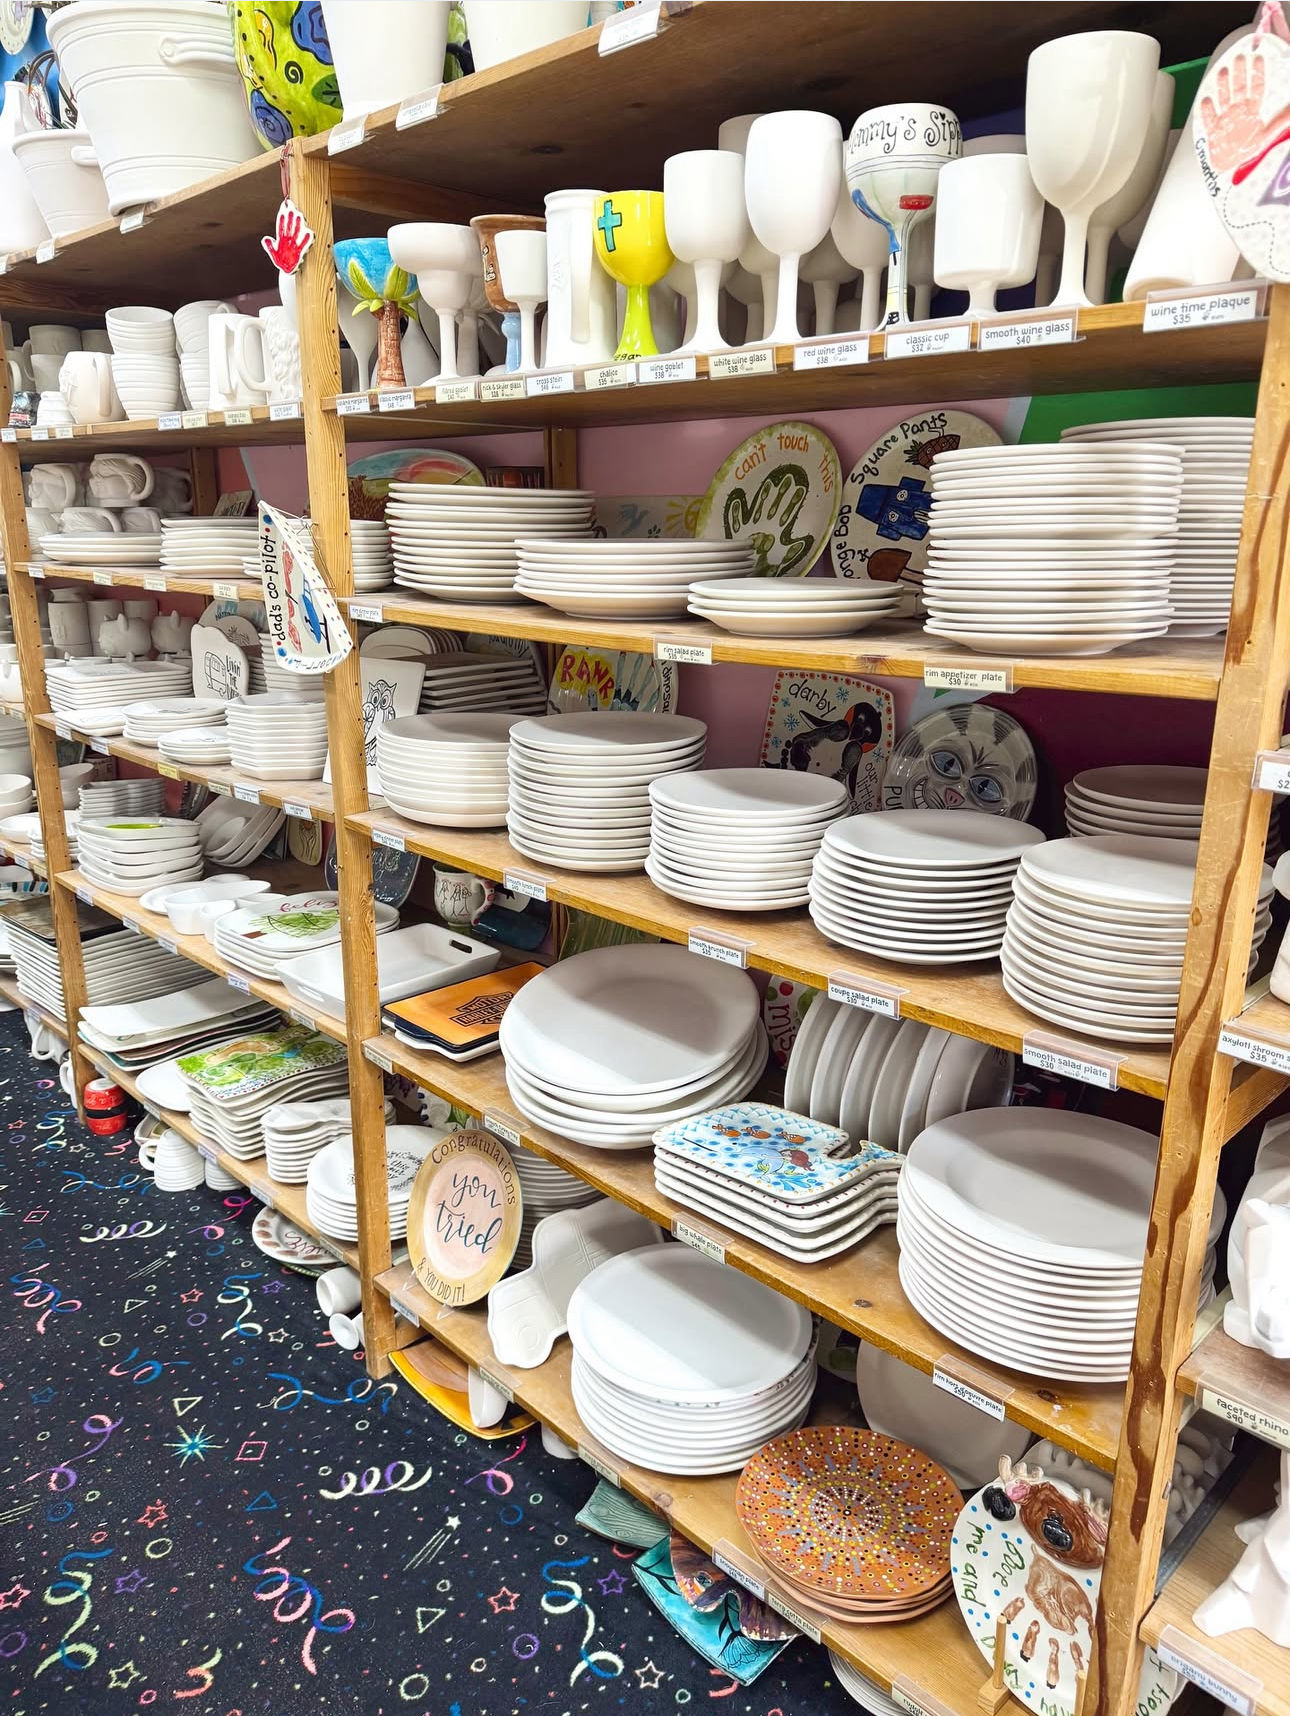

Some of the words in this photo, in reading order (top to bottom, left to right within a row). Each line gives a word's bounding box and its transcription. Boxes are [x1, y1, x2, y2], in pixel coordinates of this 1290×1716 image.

[1151, 305, 1177, 317] wine
[1180, 302, 1206, 314] time
[1208, 296, 1251, 313] plaque
[1173, 313, 1191, 325] $35
[906, 334, 933, 345] classic
[934, 331, 950, 342] cup
[985, 327, 1020, 340] smooth
[1021, 325, 1043, 336] wine
[1045, 322, 1071, 336] glass
[1016, 335, 1032, 345] $40
[713, 356, 731, 367] white
[732, 356, 748, 365] wine
[749, 353, 767, 364] glass
[803, 349, 816, 358] red
[817, 347, 836, 356] wine
[837, 343, 858, 355] glass
[734, 442, 767, 481] can't
[777, 432, 809, 453] touch
[818, 451, 834, 493] this
[851, 434, 898, 484] Square
[900, 412, 948, 439] Pants
[834, 504, 852, 538] Bob
[260, 533, 279, 600] co-pilot
[836, 540, 857, 579] onge
[267, 603, 286, 641] dad's
[560, 654, 615, 700] RAWR
[925, 669, 939, 677] rim
[940, 669, 977, 680] appetizer
[981, 672, 1003, 682] plate
[948, 678, 962, 686] $30
[788, 678, 837, 718] darby
[864, 762, 879, 784] our
[830, 986, 850, 998] coupe
[851, 991, 870, 1002] salad
[871, 997, 889, 1008] plate
[1024, 1047, 1056, 1063] smooth
[1058, 1057, 1082, 1071] salad
[1084, 1065, 1108, 1078] plate
[1039, 1060, 1054, 1070] $30
[1252, 1044, 1285, 1060] shroom
[431, 1133, 517, 1205] Congratulations
[451, 1173, 502, 1208] you
[436, 1200, 503, 1254] tried
[416, 1257, 425, 1273] &
[424, 1269, 438, 1292] YOU
[439, 1283, 452, 1301] DID
[452, 1283, 466, 1303] IT!
[1216, 1398, 1257, 1421] faceted
[1259, 1417, 1289, 1436] rhino
[1226, 1411, 1244, 1424] $90
[966, 1521, 986, 1555] me
[960, 1562, 987, 1608] and
